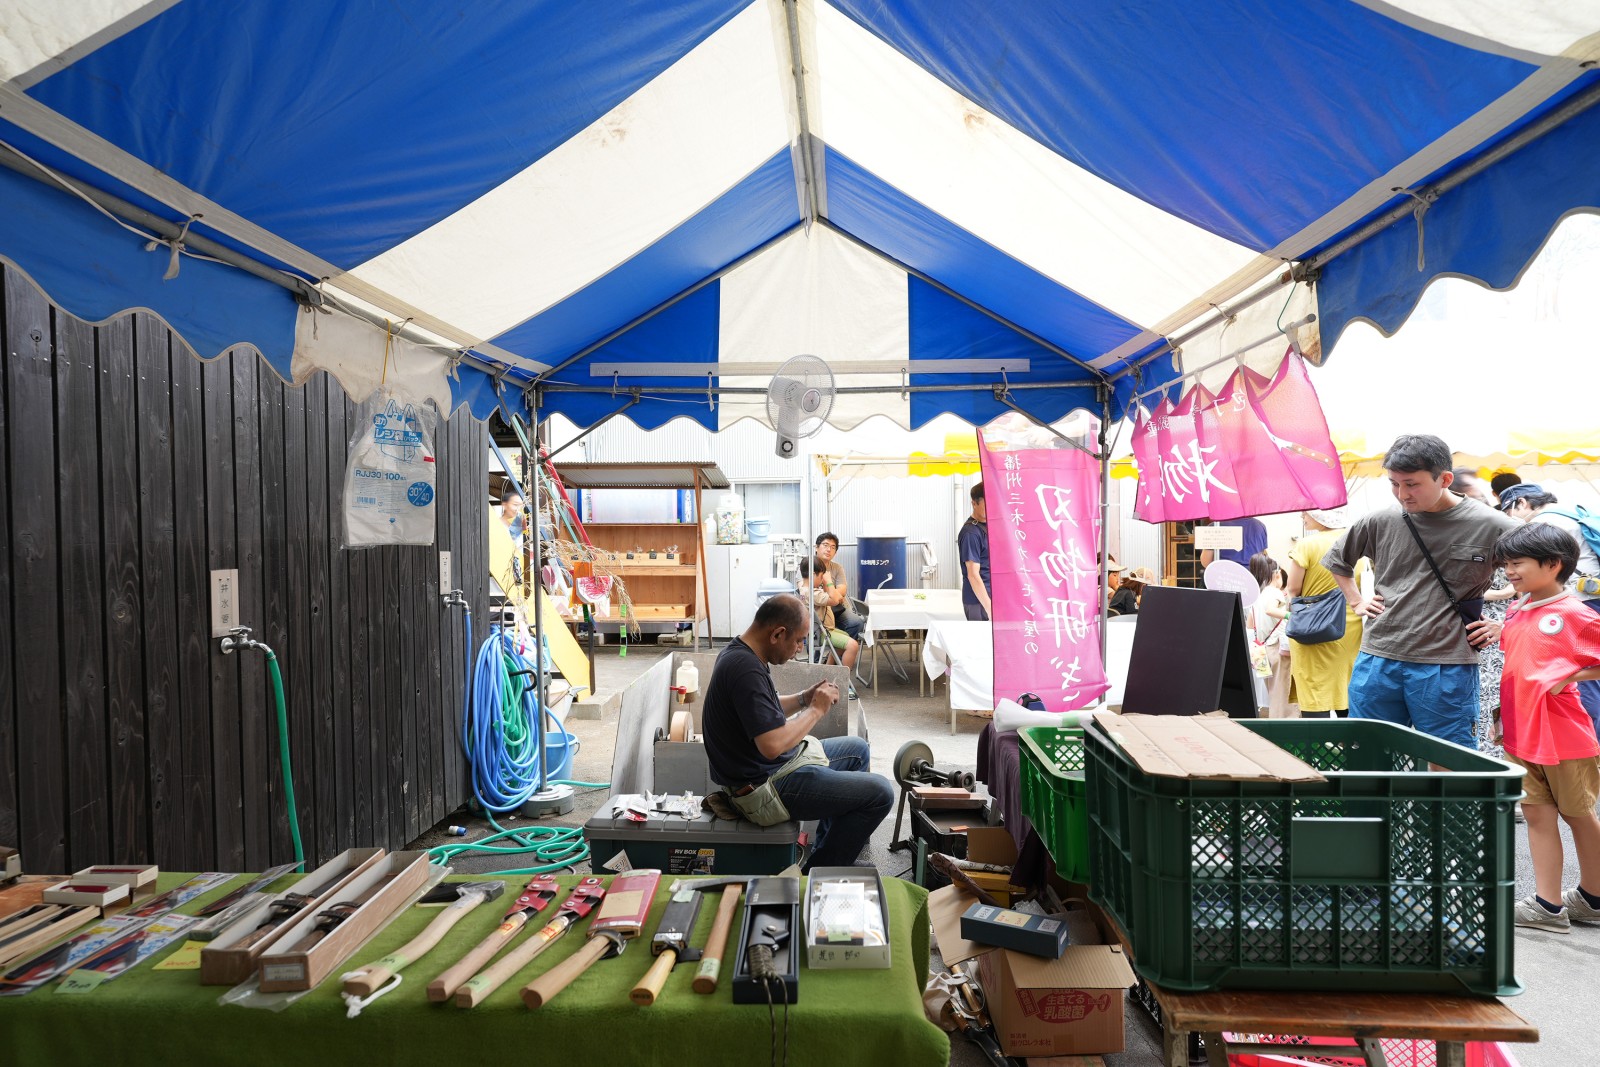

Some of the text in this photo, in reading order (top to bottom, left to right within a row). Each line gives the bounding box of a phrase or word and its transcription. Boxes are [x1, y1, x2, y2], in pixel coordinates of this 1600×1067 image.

[1046, 994, 1085, 1005] 生きてる
[1043, 1005, 1086, 1020] 乳酸菌
